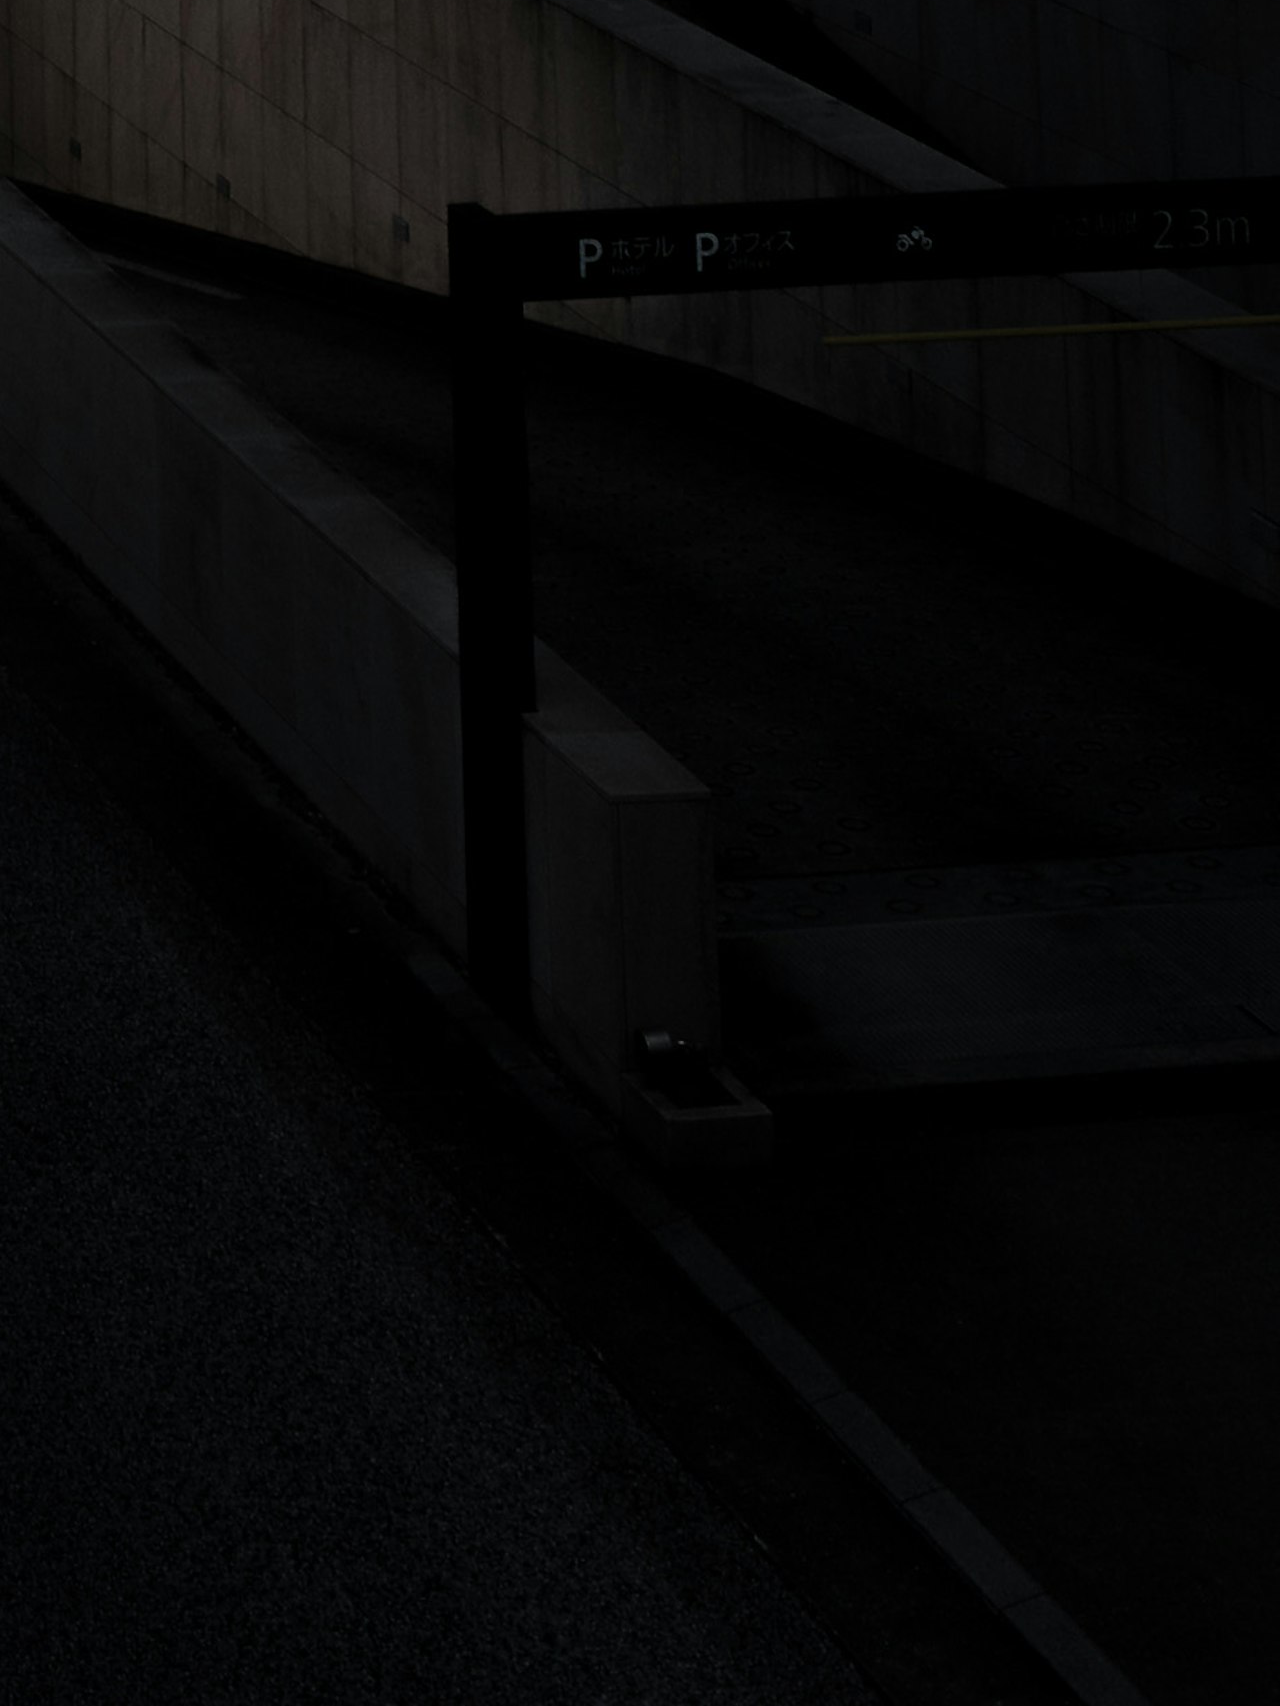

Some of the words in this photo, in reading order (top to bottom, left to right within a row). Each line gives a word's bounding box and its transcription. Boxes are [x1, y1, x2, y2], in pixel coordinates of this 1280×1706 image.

[578, 237, 604, 279] P
[611, 234, 676, 260] ホテル
[695, 231, 720, 273] P
[724, 229, 795, 255] オフィス
